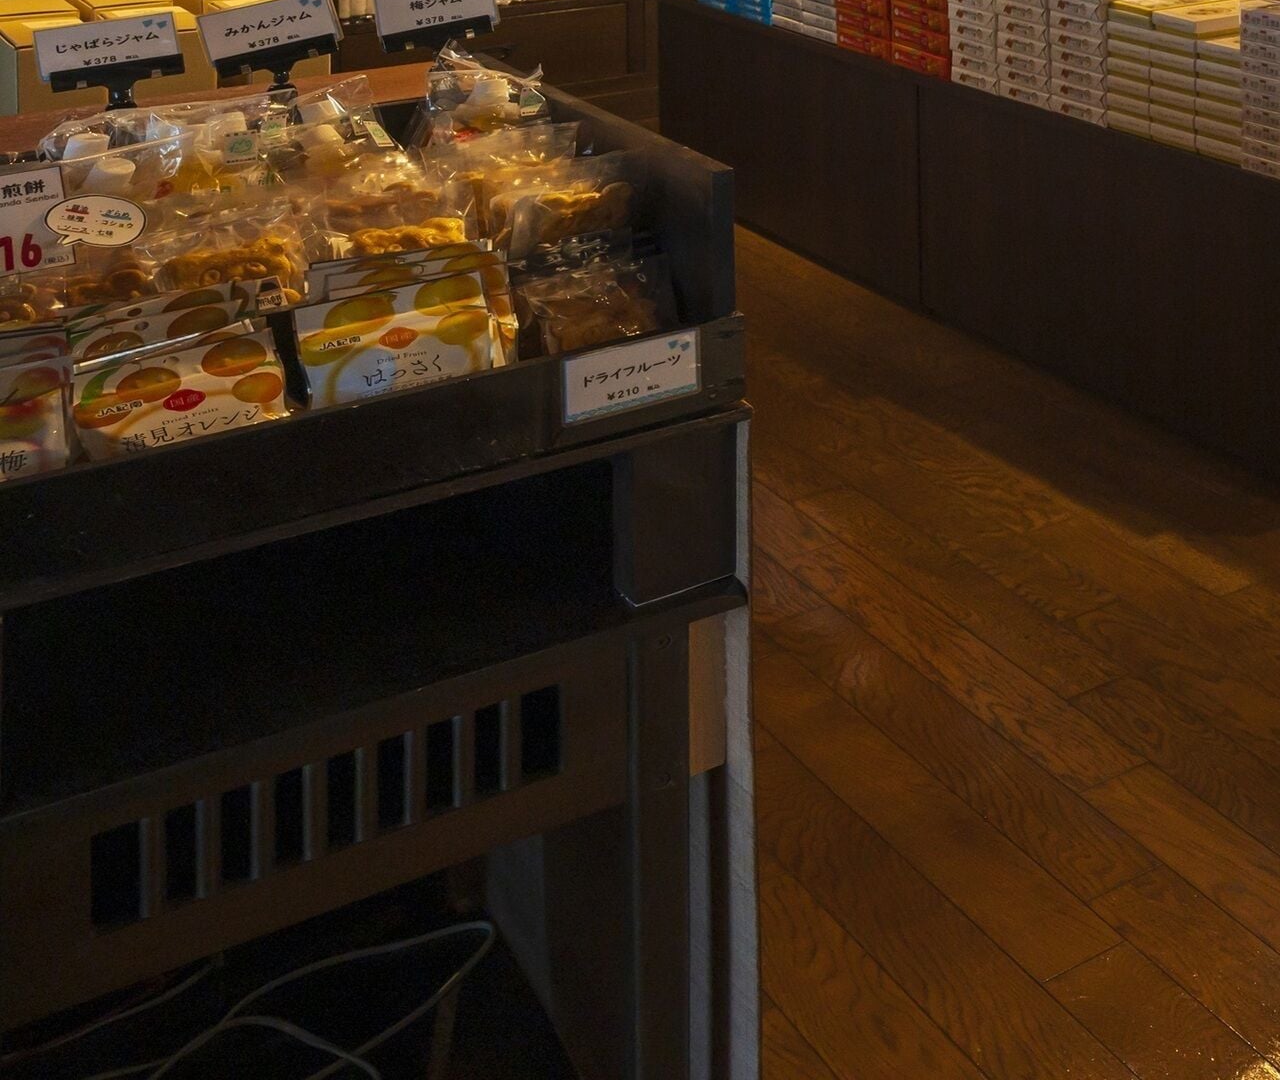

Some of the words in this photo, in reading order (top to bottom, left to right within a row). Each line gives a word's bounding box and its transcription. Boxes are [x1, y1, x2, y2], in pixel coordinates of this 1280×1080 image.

[224, 9, 313, 39] みかんジャム
[415, 15, 445, 27] ¥378
[55, 29, 160, 54] じゃばらジャム
[248, 36, 281, 49] ¥378
[82, 54, 117, 66] ¥378
[1, 179, 46, 199] 煎餅
[25, 193, 59, 205] Senbei
[362, 354, 445, 388] はっさく
[583, 352, 683, 389] ドライフルーツ
[607, 385, 640, 401] ¥210
[97, 399, 143, 418] JA紀南
[122, 404, 261, 453] 清見オレンジ
